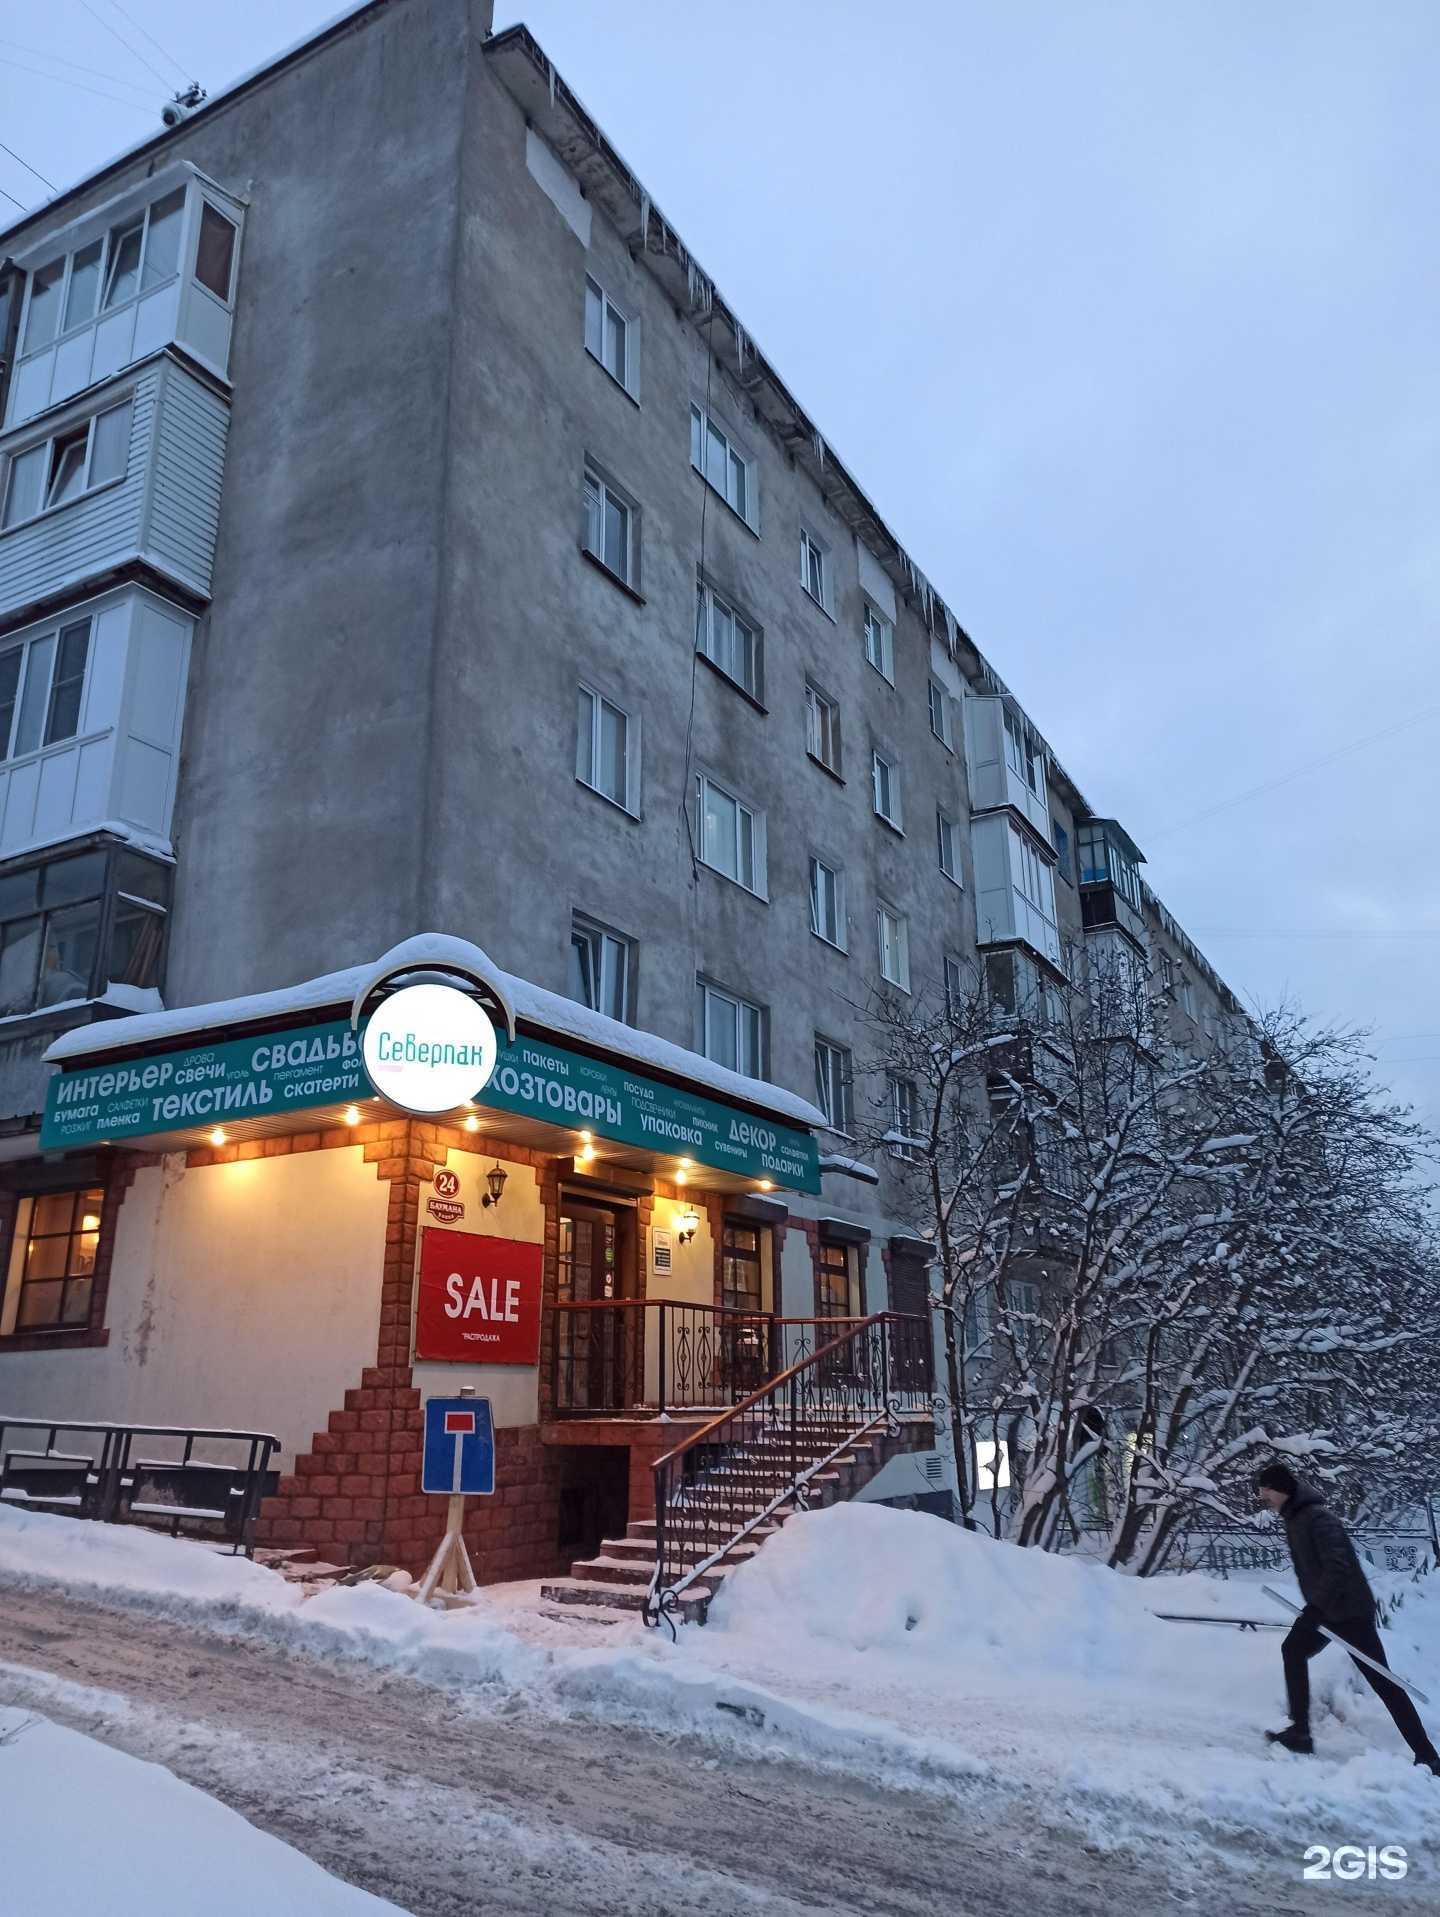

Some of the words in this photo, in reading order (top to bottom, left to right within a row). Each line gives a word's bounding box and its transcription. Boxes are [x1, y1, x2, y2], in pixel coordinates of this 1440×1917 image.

[175, 1062, 226, 1085] СВЕЧИ
[341, 1057, 362, 1071] ФО
[523, 1049, 569, 1076] ПАКЕТЫ
[283, 1073, 360, 1098] СКАТЕРТИ
[485, 1064, 622, 1126] ХОЗТОВАРЫ
[623, 1081, 655, 1100] ПОСУДА
[152, 1079, 273, 1122] ТЕКСТИЛЬ
[54, 1104, 99, 1123] БУМАГА
[96, 1112, 141, 1130] ПЛЕНКА
[640, 1113, 704, 1146] УПАКОВКА
[729, 1119, 777, 1152] ДЕКОР
[761, 1153, 804, 1178] ПОДАРКИ
[439, 1174, 456, 1193] 24
[444, 1272, 521, 1323] SALE
